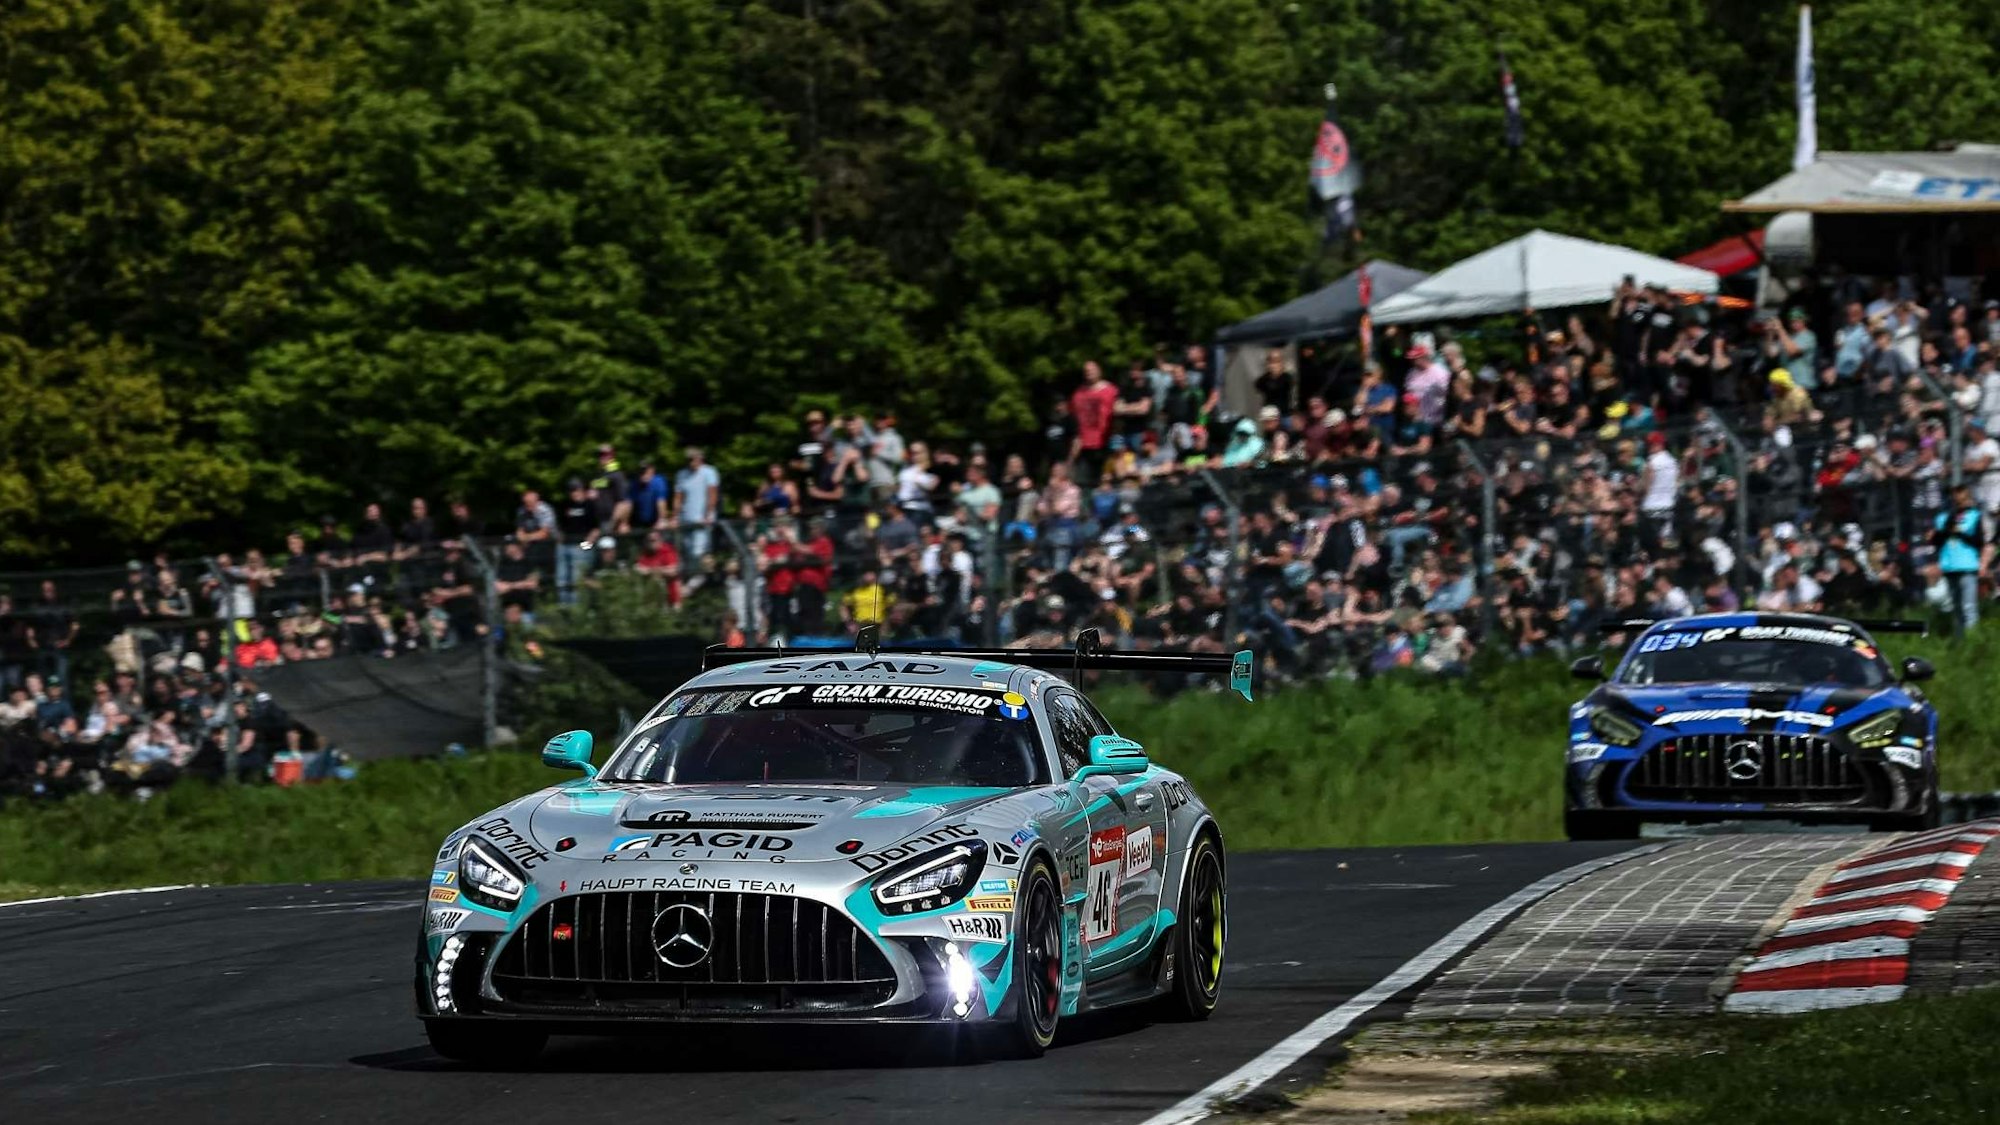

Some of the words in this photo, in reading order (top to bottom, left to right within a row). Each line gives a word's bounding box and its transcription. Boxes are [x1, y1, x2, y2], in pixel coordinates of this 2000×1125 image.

[762, 660, 947, 675] SAAD
[811, 685, 884, 699] GRAN
[869, 697, 916, 706] DRIVING
[918, 700, 985, 716] SIMULATOR
[475, 817, 550, 869] Dorint
[650, 832, 794, 852] PAGID
[849, 823, 979, 873] Dorint
[601, 849, 786, 864] RACING
[580, 878, 647, 891] HAUPT
[652, 878, 731, 890] RACING
[738, 879, 795, 894] TEAM
[969, 897, 1012, 909] PIRELLI
